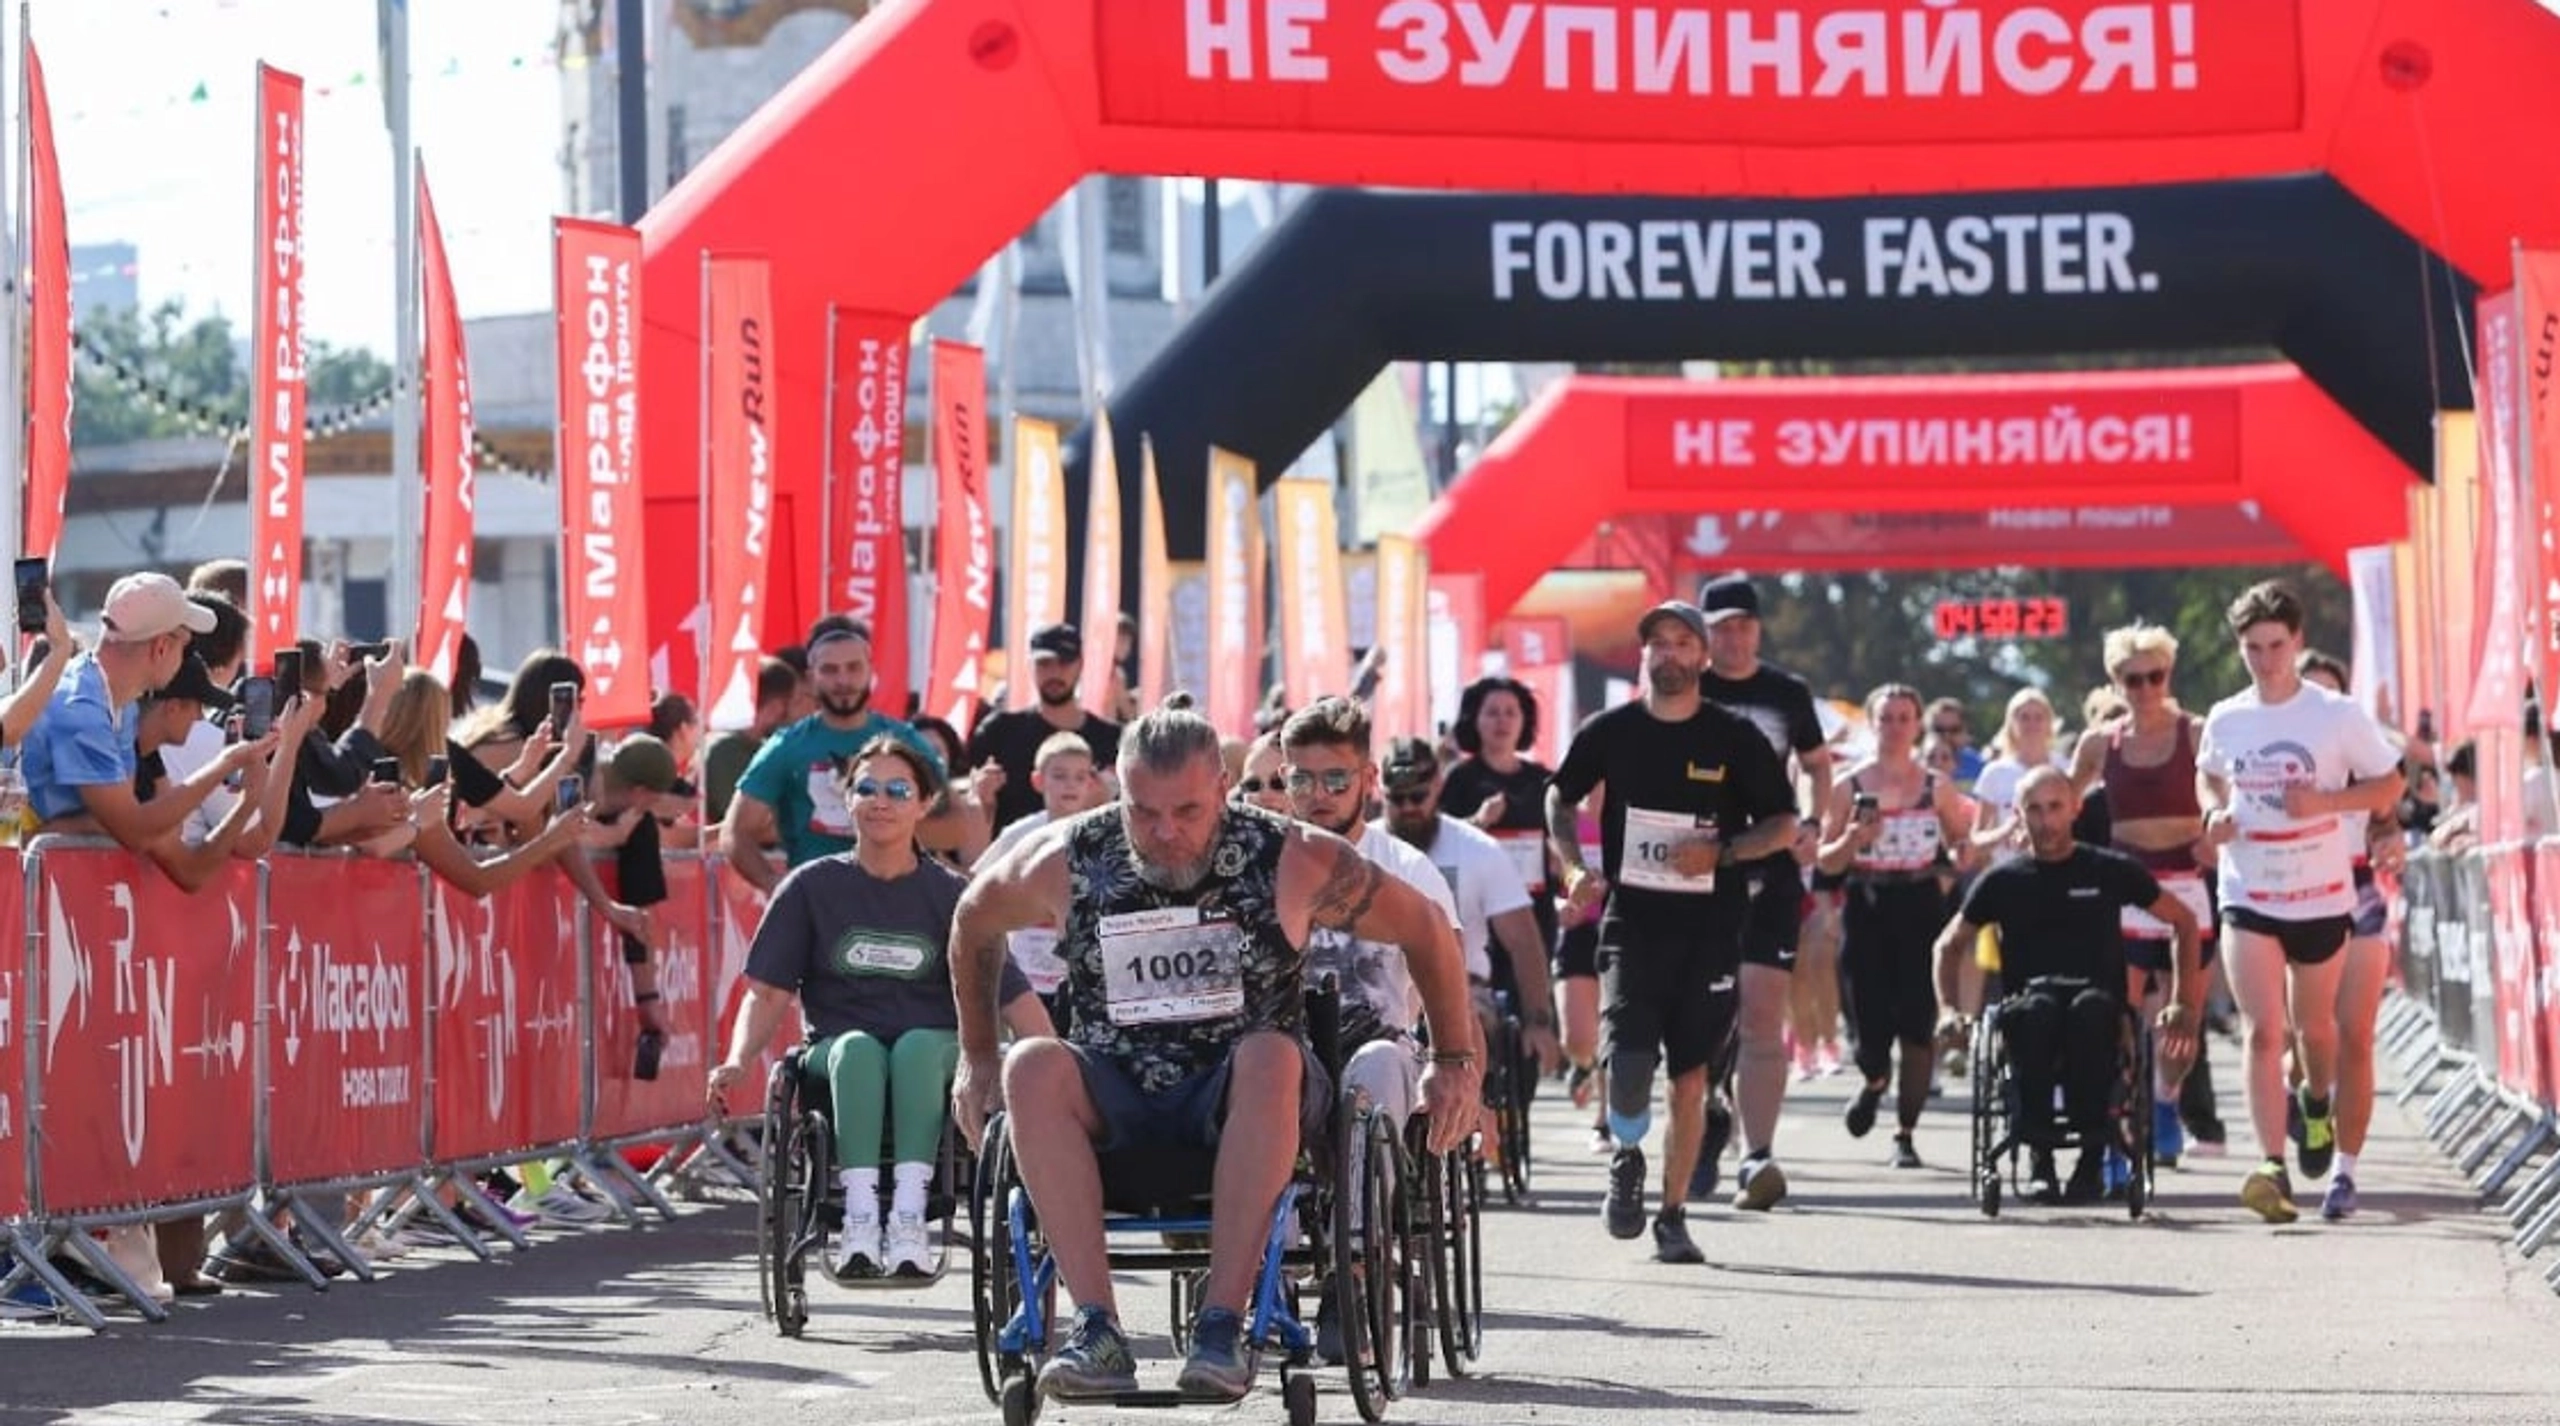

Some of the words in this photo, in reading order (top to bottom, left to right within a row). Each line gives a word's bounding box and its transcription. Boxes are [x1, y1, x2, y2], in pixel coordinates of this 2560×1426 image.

[1186, 0, 1329, 80] НЕ
[1375, 0, 2198, 97] ЗУПИНЯЙСЯ!
[1491, 220, 1846, 299] FOREVER.
[1864, 212, 2159, 296] FASTER.
[269, 111, 294, 518] Марафон
[582, 255, 618, 598] Марафон
[1673, 420, 1754, 465] НЕ
[1776, 407, 2191, 465] ЗУПИНЯЙСЯ!
[848, 339, 881, 629] Марафон
[1638, 840, 1669, 863] 10
[1127, 949, 1217, 983] 1002
